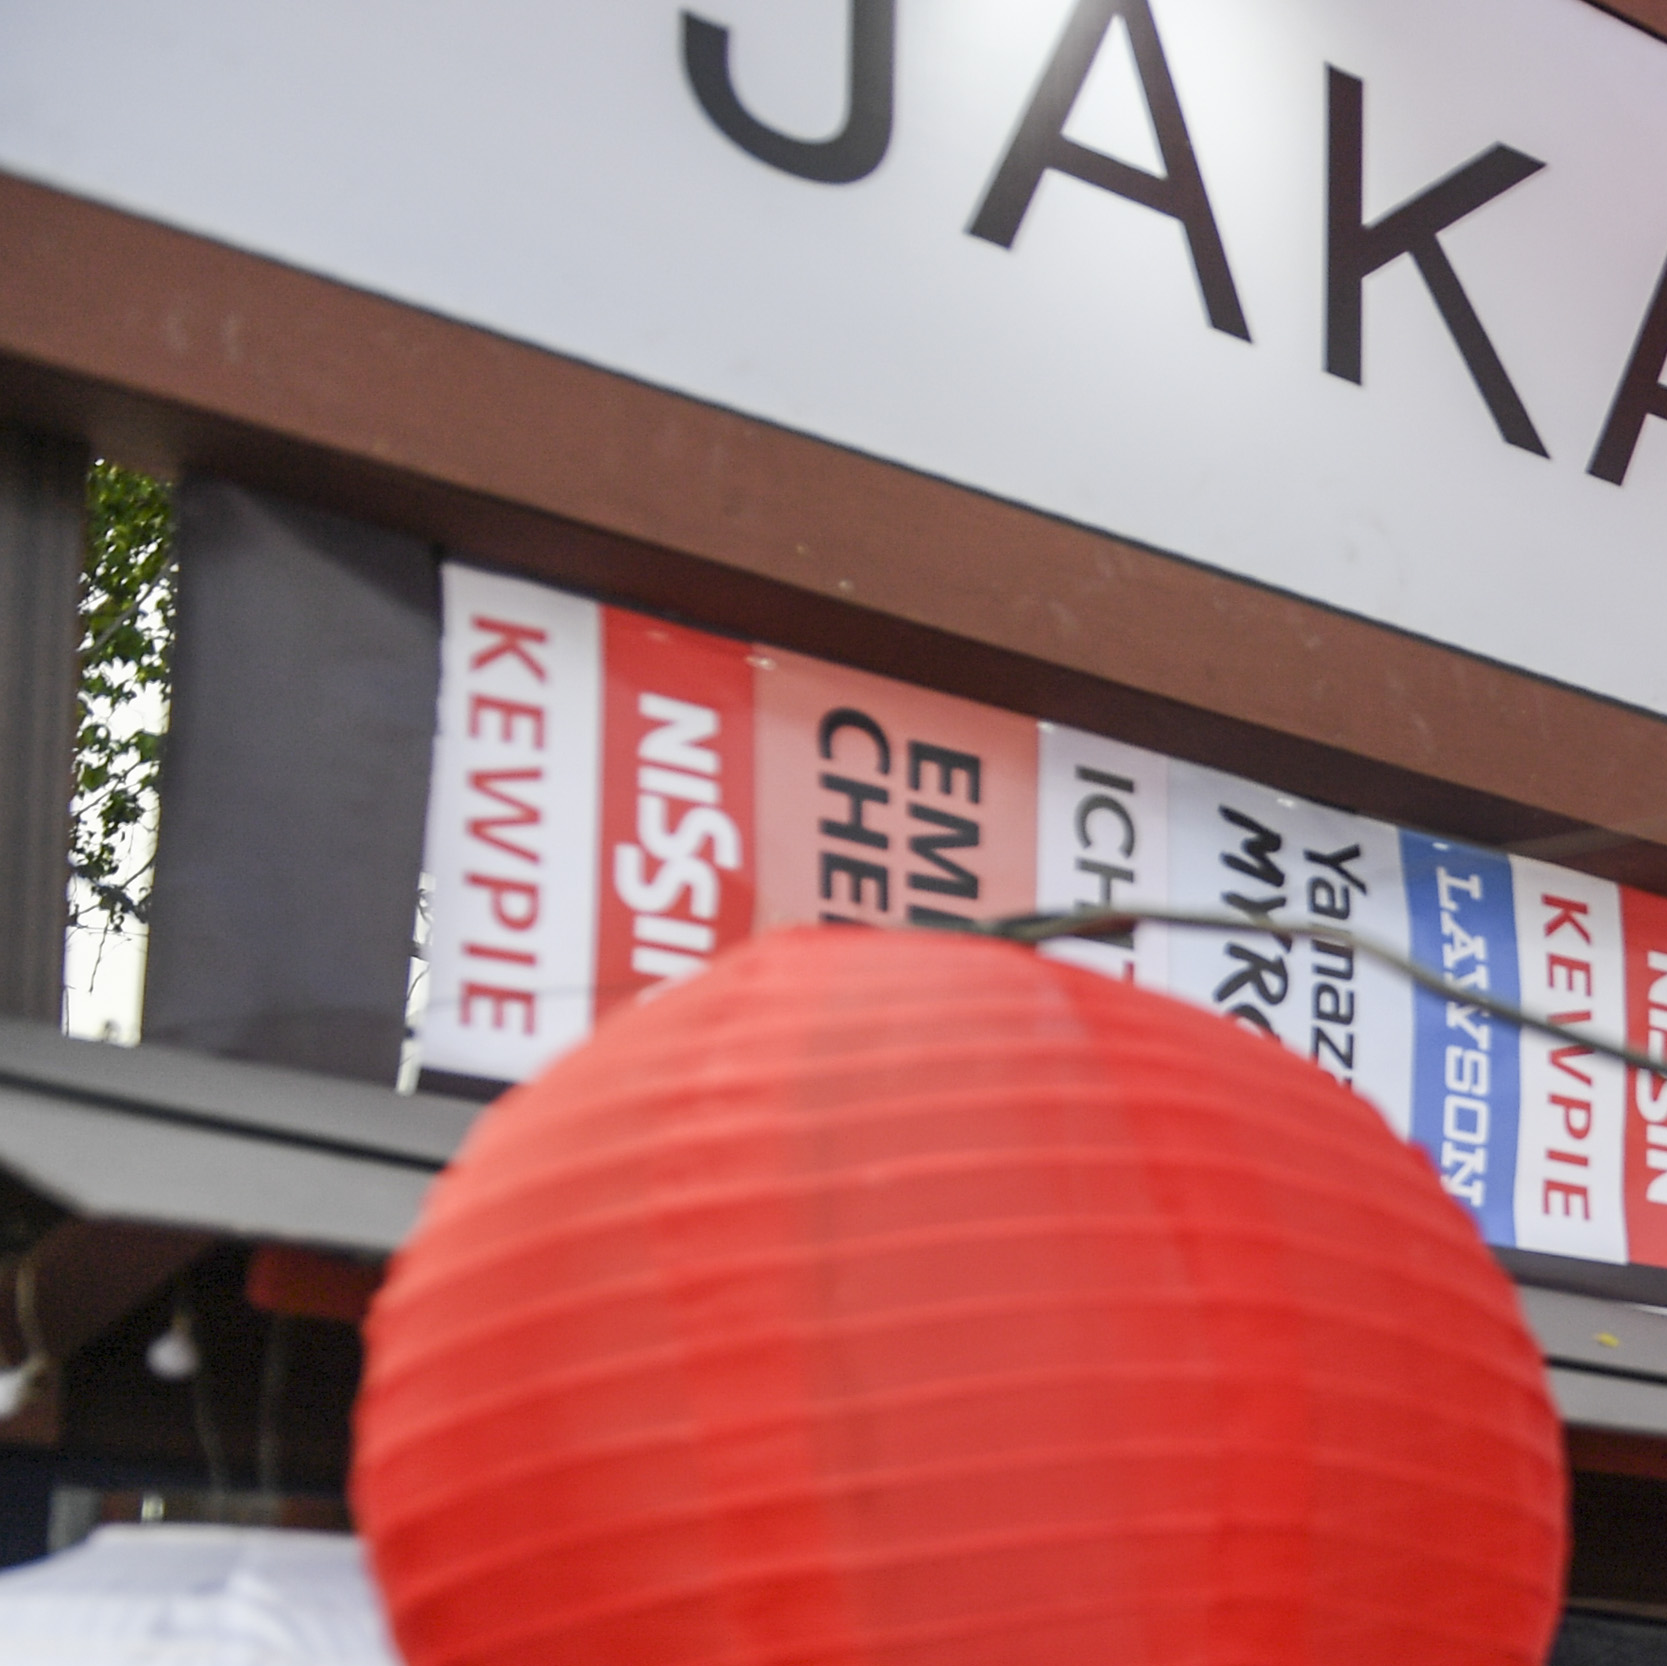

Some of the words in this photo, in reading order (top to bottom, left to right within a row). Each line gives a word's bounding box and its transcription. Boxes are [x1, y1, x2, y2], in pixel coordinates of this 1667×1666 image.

[459, 612, 552, 1037] KEWPIE
[817, 706, 892, 926] CHE
[906, 738, 982, 930] EMI
[1303, 843, 1367, 1086] Yamaz
[1436, 866, 1489, 1207] LAWSON
[1541, 893, 1593, 1221] KEWPIE
